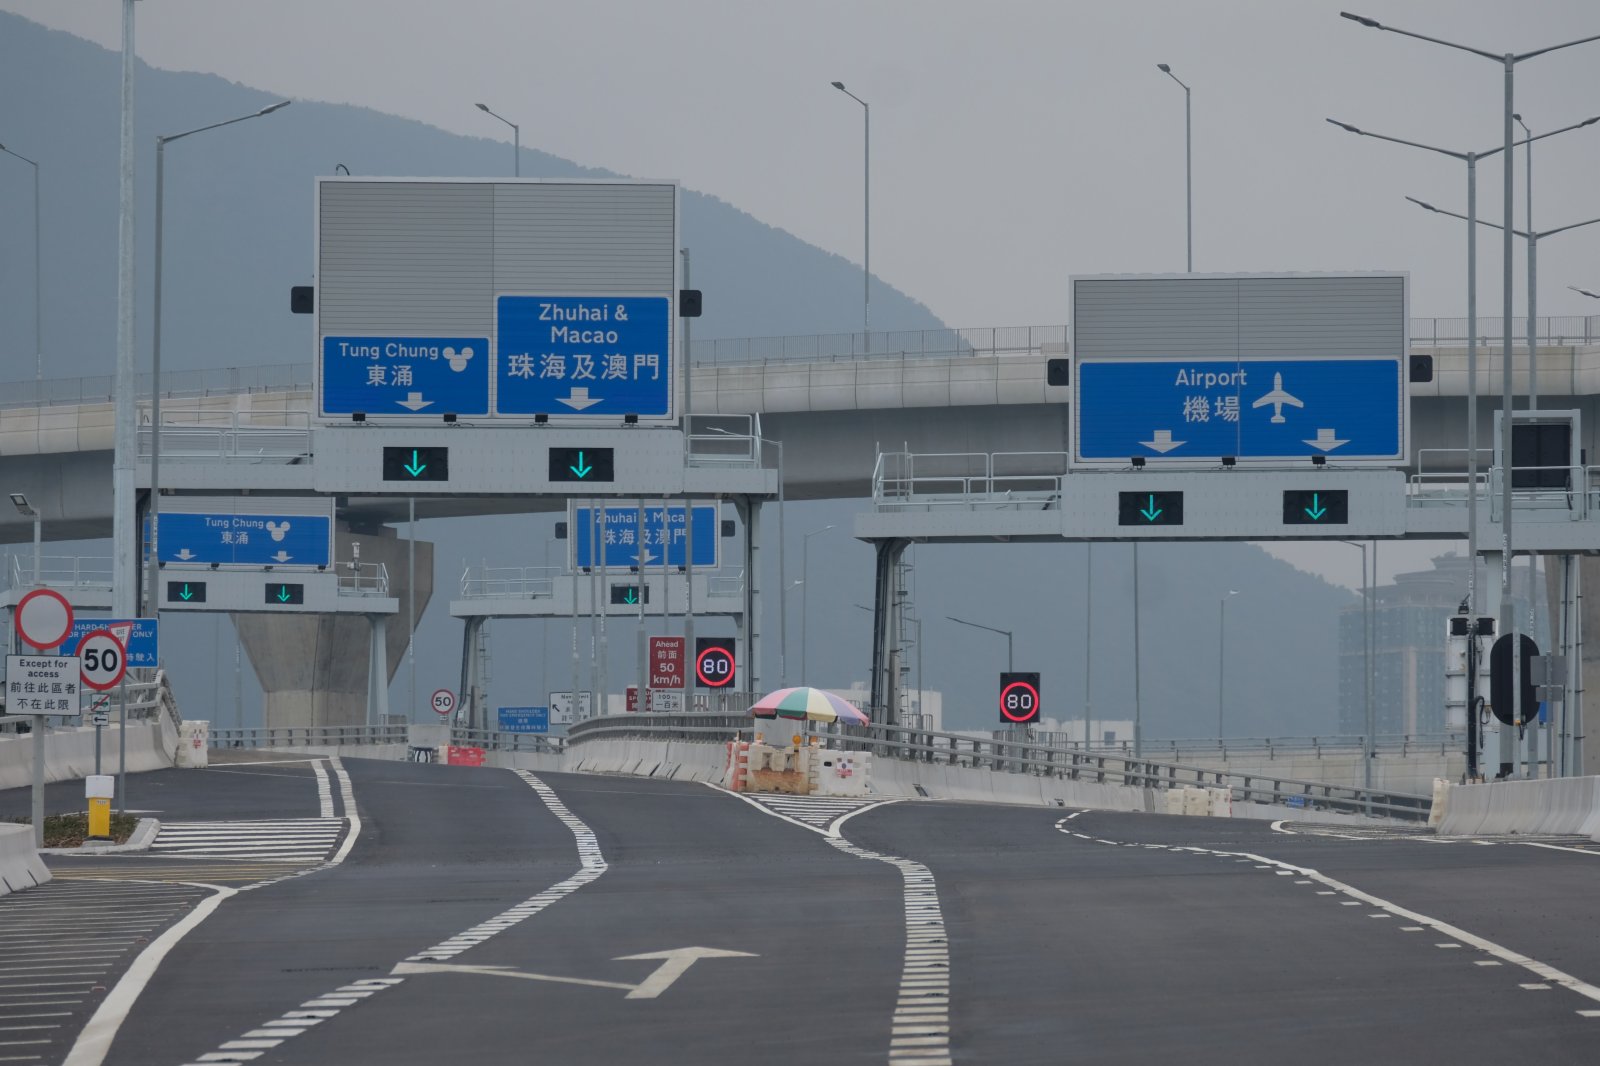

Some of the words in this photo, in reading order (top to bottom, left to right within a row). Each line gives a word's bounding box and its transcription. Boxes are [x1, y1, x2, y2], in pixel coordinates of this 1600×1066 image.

[539, 304, 608, 322] Zhuhai
[614, 304, 629, 322] &
[550, 326, 619, 344] Macao
[339, 343, 381, 360] Tung
[385, 343, 439, 361] Chung
[507, 353, 660, 381] 珠海及澳門
[366, 365, 414, 387] 東涌
[1175, 368, 1248, 389] Airport
[1182, 395, 1241, 423] 機場
[205, 517, 230, 529] Tung
[232, 518, 265, 530] Chung
[595, 512, 638, 524] Zhuhai
[220, 531, 249, 545] 東涌
[132, 631, 153, 639] ONLY
[655, 640, 679, 648] Ahead
[84, 648, 118, 672] 50
[657, 650, 677, 660] 前面
[19, 658, 53, 669] Except
[54, 659, 68, 669] for
[659, 662, 675, 673] 50
[703, 658, 728, 674] 80
[27, 670, 60, 678] access
[653, 674, 681, 687] km/h
[10, 682, 77, 695] 前往此區者
[17, 698, 70, 711] 不在此限
[435, 696, 451, 707] 50
[1007, 694, 1032, 709] 80
